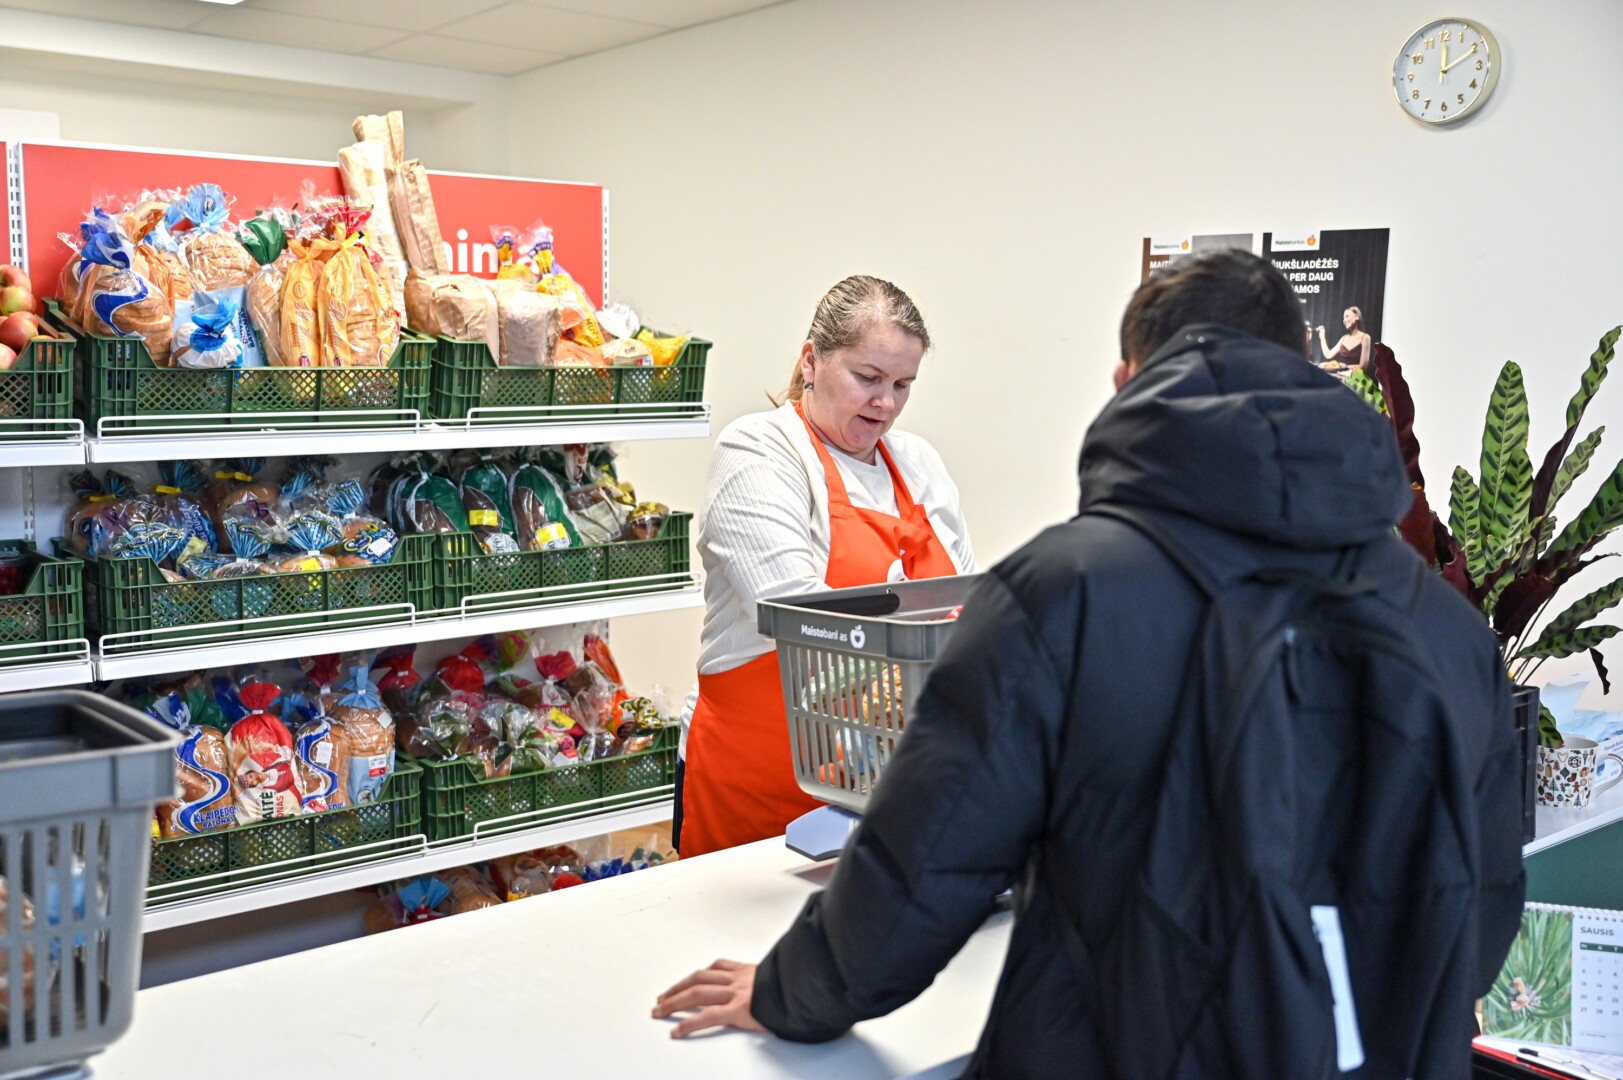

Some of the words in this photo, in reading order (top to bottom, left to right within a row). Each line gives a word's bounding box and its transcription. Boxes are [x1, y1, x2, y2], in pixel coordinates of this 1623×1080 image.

[1438, 30, 1451, 42] 12
[1458, 31, 1464, 43] 1
[1423, 37, 1435, 50] 11
[1412, 53, 1424, 65] 10
[1475, 60, 1483, 71] 3
[1407, 71, 1414, 82] 9
[1469, 78, 1477, 89] 4
[1412, 89, 1419, 99] 8
[1457, 94, 1464, 104] 5
[1424, 98, 1431, 110] 7
[1441, 102, 1447, 112] 6
[1289, 272, 1307, 281] PER
[1308, 272, 1334, 281] DAUG
[1291, 284, 1320, 294] AMOS
[260, 791, 274, 819] AITĖ
[276, 795, 284, 818] ONAS
[1580, 926, 1614, 936] SAUSIS
